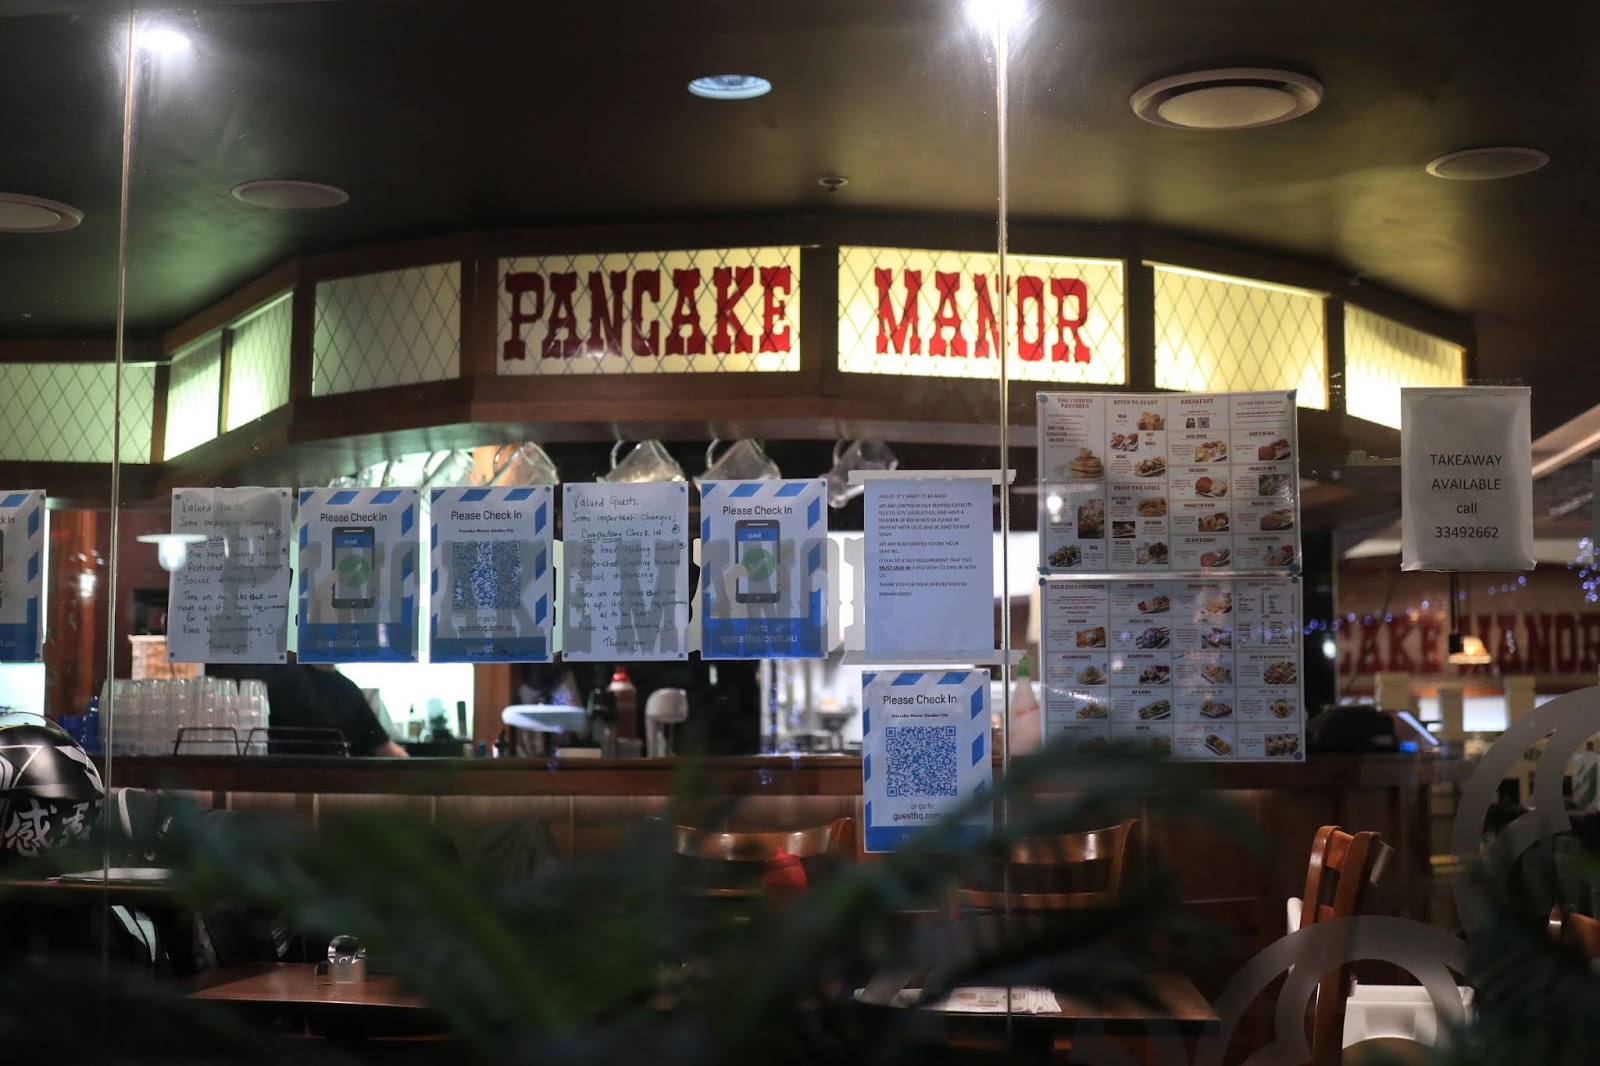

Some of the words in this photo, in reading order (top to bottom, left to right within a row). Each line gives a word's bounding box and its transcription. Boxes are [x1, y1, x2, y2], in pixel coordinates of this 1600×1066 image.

[502, 265, 793, 360] PANCAKE
[875, 267, 1091, 364] MANOR
[1430, 454, 1502, 466] TAKEAWAY
[1431, 478, 1501, 490] AVAILABLE
[573, 495, 604, 508] Valued
[722, 505, 753, 515] Please
[754, 505, 783, 515] Check
[784, 505, 793, 514] In
[1456, 502, 1477, 514] call
[320, 512, 349, 523] Please
[350, 512, 378, 522] Check
[378, 513, 387, 522] In
[450, 511, 482, 520] Please
[483, 510, 512, 520] Check
[513, 510, 522, 519] In
[571, 512, 590, 523] Some
[1435, 526, 1499, 538] 33492662
[577, 572, 605, 582] Social
[883, 695, 914, 705] Please
[916, 694, 946, 704] Check
[948, 694, 957, 703] In
[918, 803, 927, 811] go
[893, 812, 942, 821] guesthq.com
